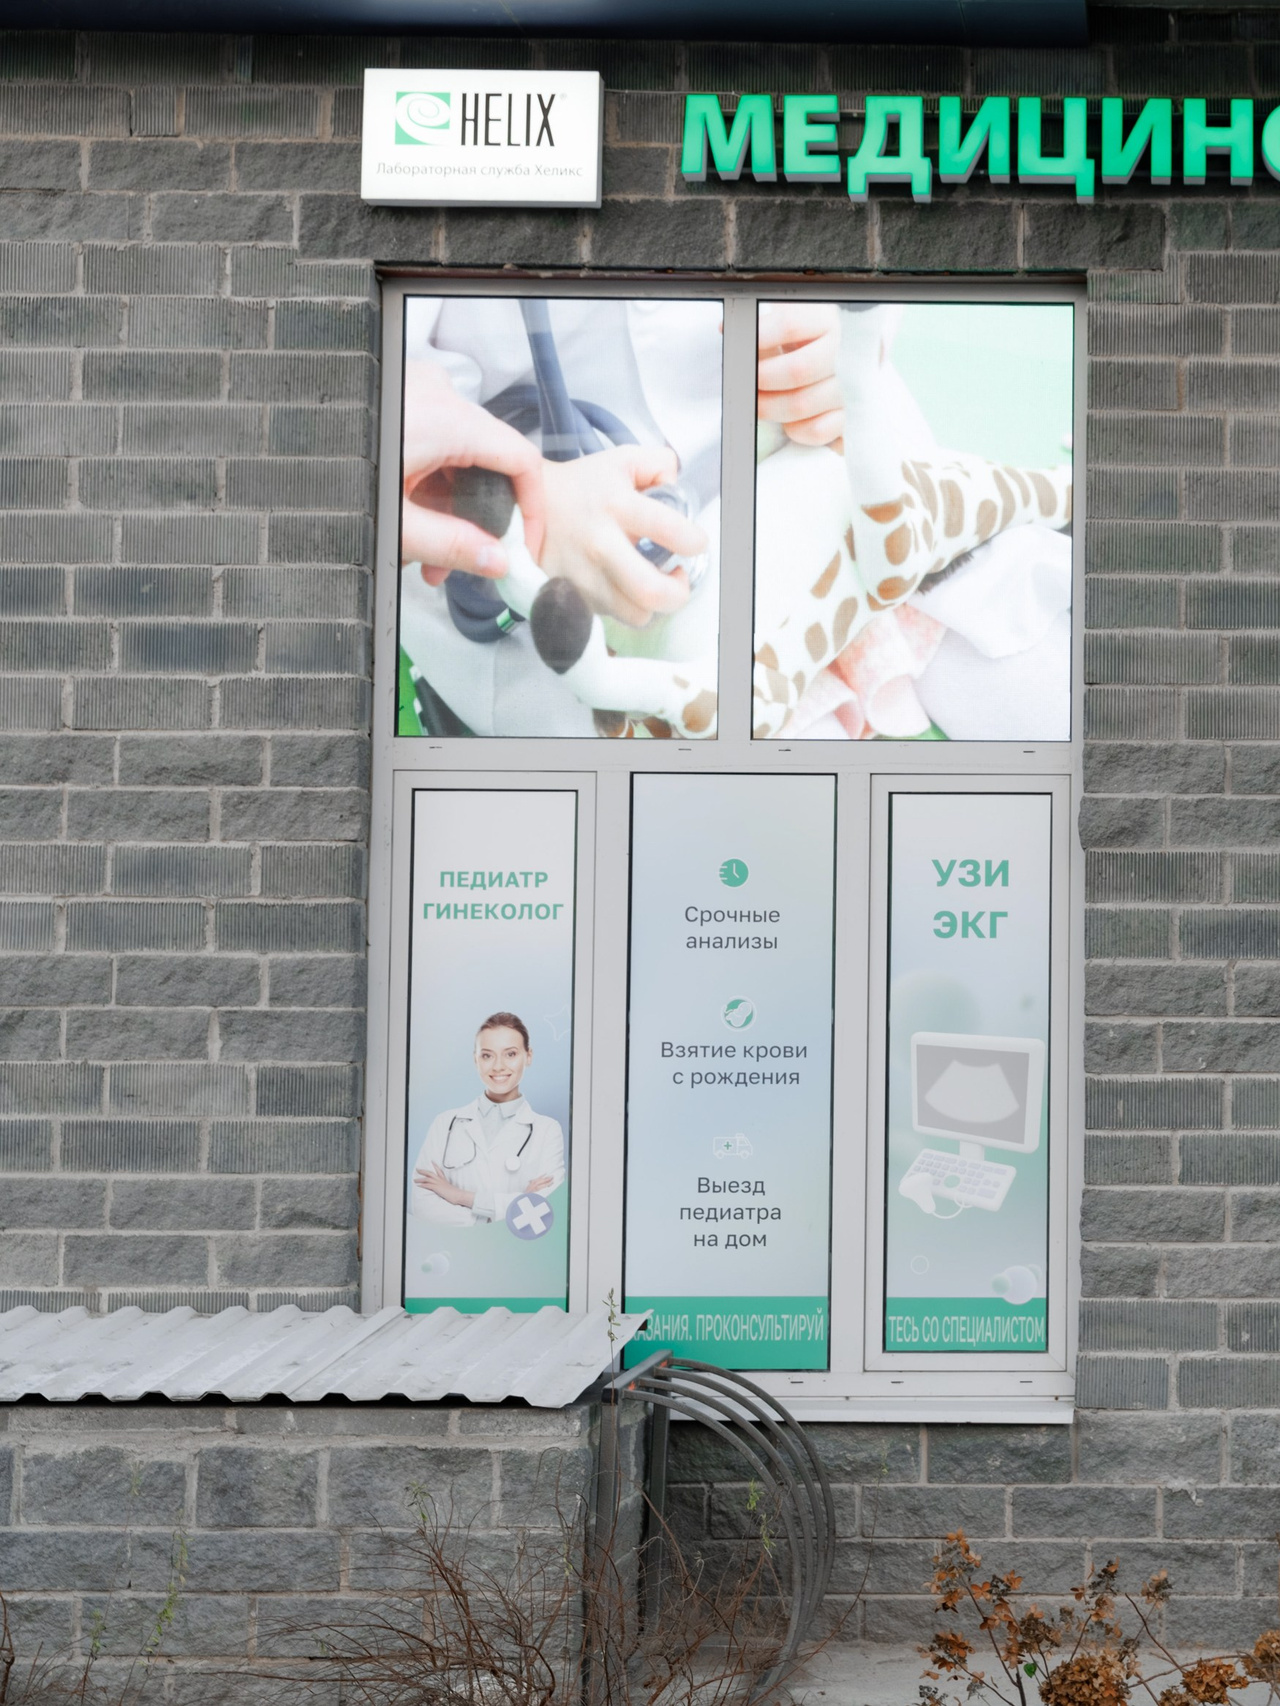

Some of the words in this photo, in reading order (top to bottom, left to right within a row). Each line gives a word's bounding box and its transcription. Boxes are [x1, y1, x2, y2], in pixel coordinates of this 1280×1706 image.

[460, 92, 556, 147] HELIX
[376, 162, 477, 177] Лабораторная
[480, 164, 531, 178] служба
[534, 164, 583, 177] Хеликс
[439, 870, 549, 891] ПЕДИАТР
[931, 858, 1010, 888] УЗИ
[423, 902, 564, 921] ГИНЕКОЛОГ
[684, 905, 781, 927] Срочные
[932, 910, 1009, 939] ЭКГ
[685, 935, 778, 950] анализы
[660, 1041, 737, 1059] Взятие
[743, 1045, 808, 1063] крови
[672, 1071, 684, 1085] с
[690, 1071, 800, 1089] рождения
[697, 1176, 766, 1197] Выезд
[680, 1207, 782, 1225] педиатра
[693, 1233, 719, 1247] на
[724, 1233, 767, 1250] дом
[696, 1307, 824, 1341] ПРОКОНСУЛЬТИРУЙ
[888, 1316, 920, 1342] ТЕСЬ
[921, 1316, 940, 1343] СО
[942, 1316, 1044, 1347] СПЕЦИАЛИСТОМ
